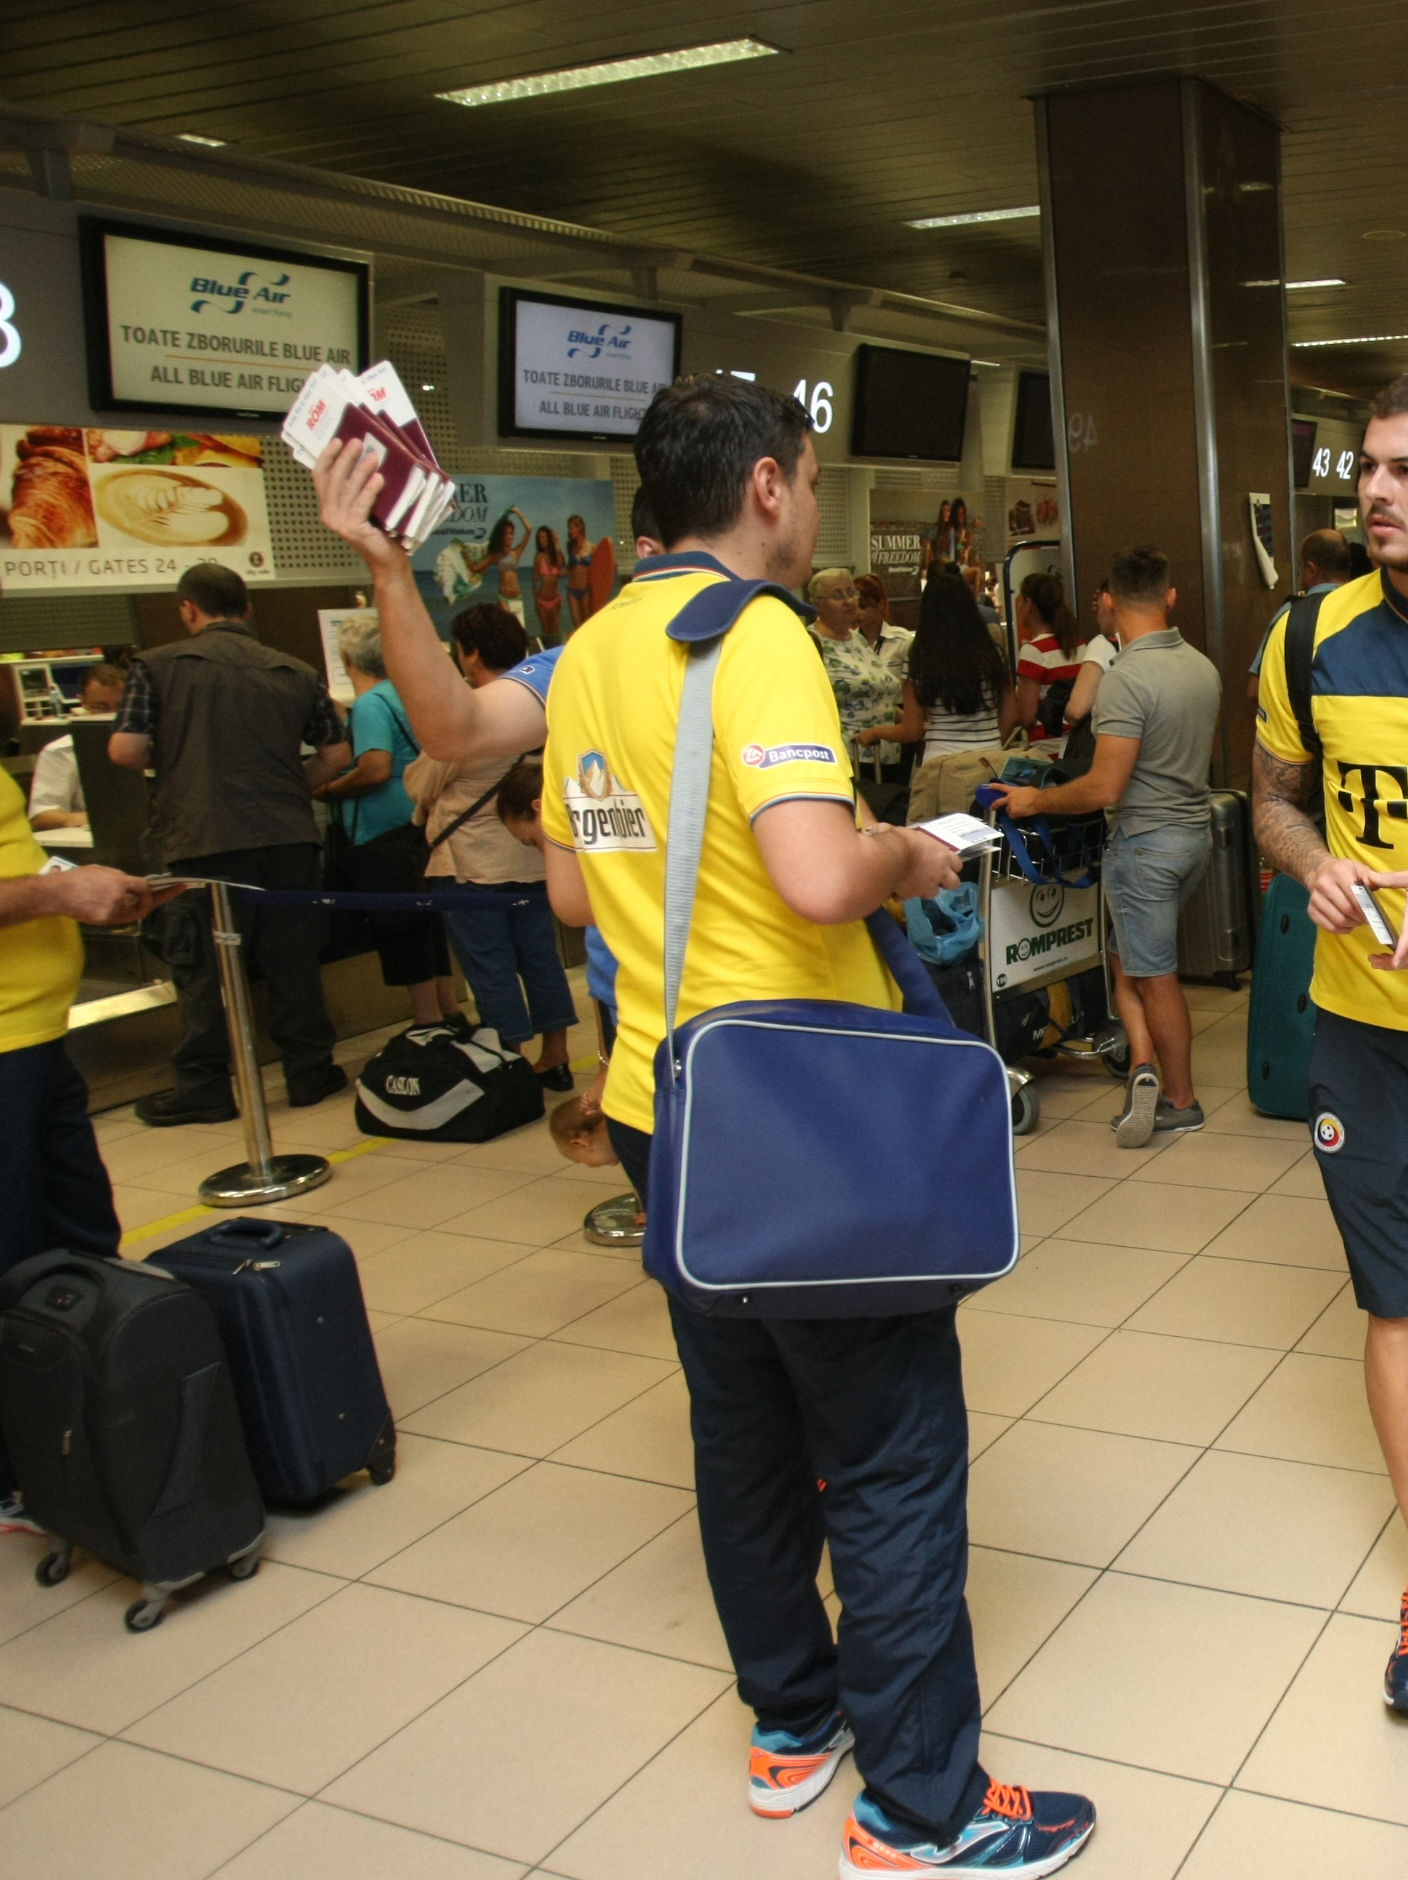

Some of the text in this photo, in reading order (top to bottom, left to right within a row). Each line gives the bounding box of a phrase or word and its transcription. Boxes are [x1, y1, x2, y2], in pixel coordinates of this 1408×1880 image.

[190, 277, 291, 303] Blue Air
[120, 325, 350, 365] TOATE ZBORURILE BLUE AIR
[568, 330, 631, 349] Blue Air
[151, 365, 304, 393] ALL BLUE AIR FLIG
[523, 369, 560, 386] TOATE
[563, 373, 622, 391] ZBORURILE
[624, 380, 649, 394] BLUE
[539, 401, 560, 414] ALL
[563, 401, 591, 417] BLUE
[593, 405, 610, 418] AIR
[1312, 447, 1331, 477] 43
[1336, 450, 1355, 479] 42
[871, 534, 921, 550] SUMMER
[89, 558, 149, 575] GATES
[156, 558, 177, 573] 24
[768, 749, 830, 763] Bancpost
[1337, 761, 1408, 849] T
[565, 798, 646, 845] rgenbier
[1006, 918, 1093, 965] ROMPREST
